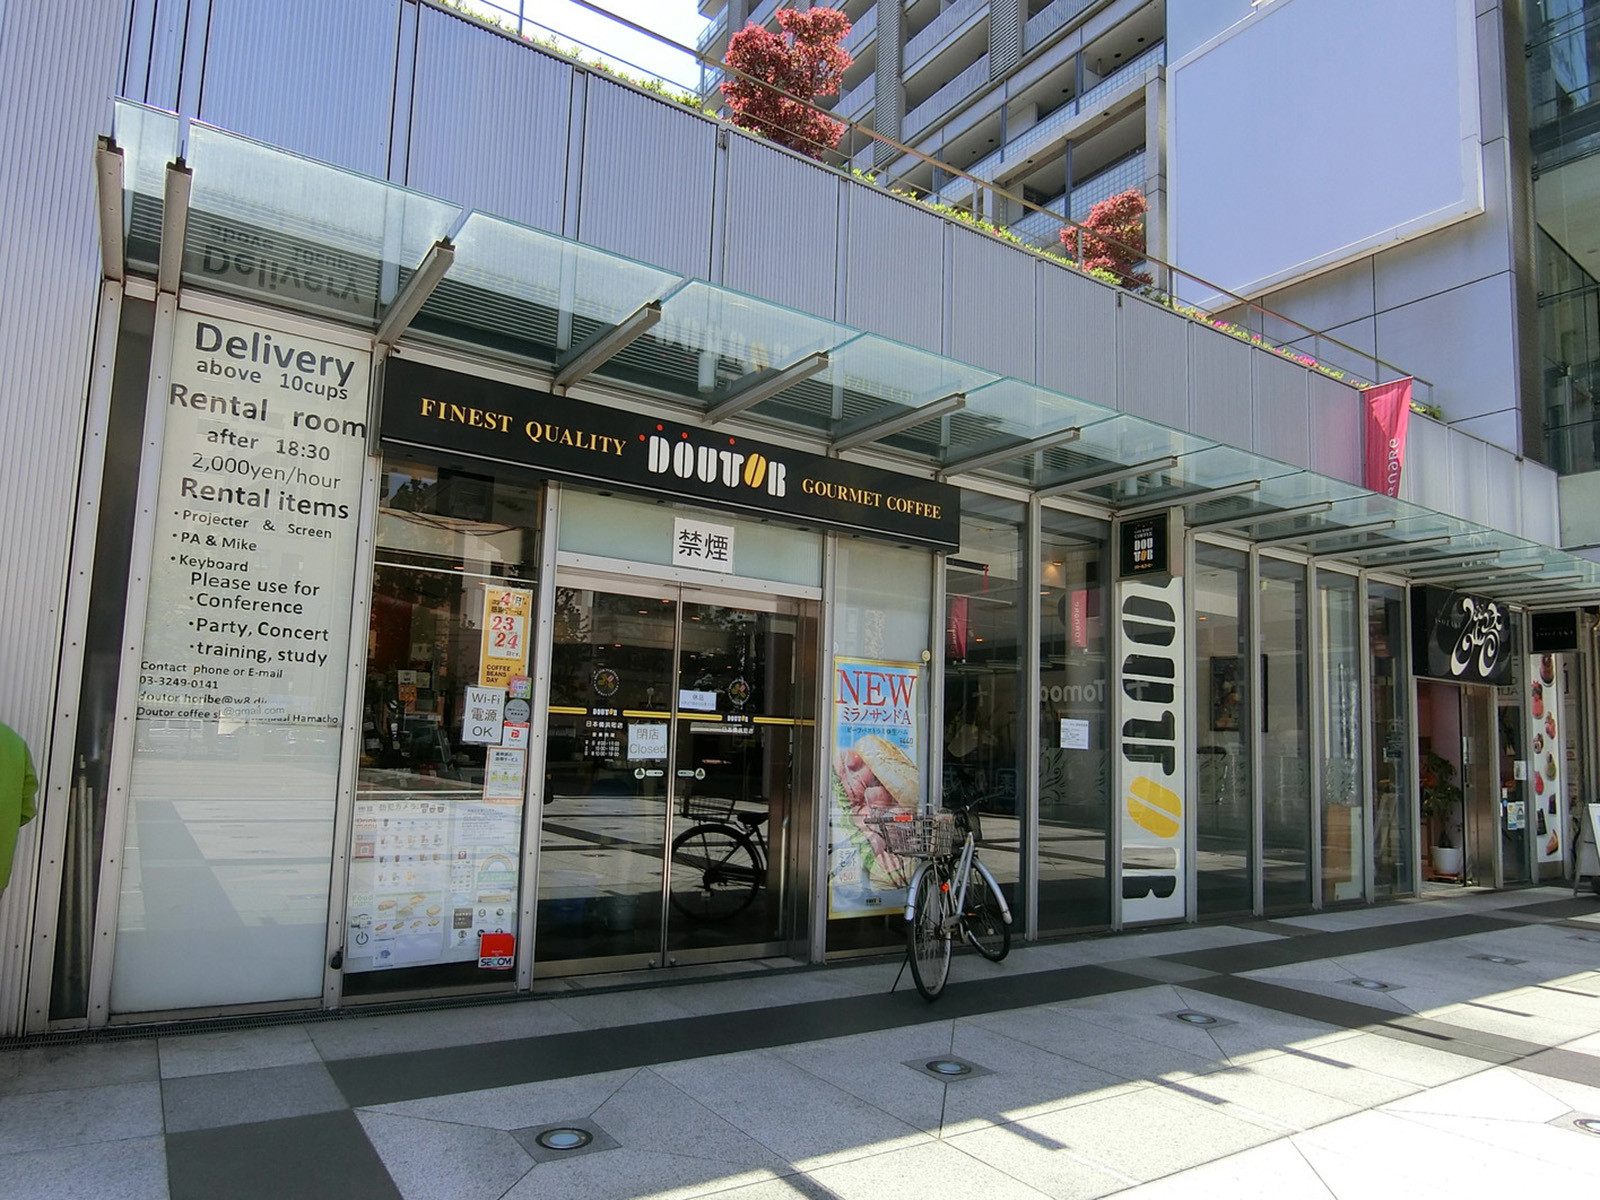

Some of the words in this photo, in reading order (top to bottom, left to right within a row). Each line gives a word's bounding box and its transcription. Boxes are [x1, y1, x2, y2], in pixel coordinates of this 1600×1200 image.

[195, 322, 355, 387] Delivery
[196, 358, 262, 383] above
[280, 373, 348, 401] 10cups
[169, 383, 268, 421] Rental
[292, 410, 367, 438] room
[420, 397, 513, 433] FINEST
[525, 421, 627, 456] QUALITY
[207, 429, 258, 449] after
[276, 439, 330, 461] 18:30
[192, 453, 341, 489] 2,000yen/hour
[647, 435, 787, 498] DOUTOR
[181, 477, 270, 508] Rental
[278, 492, 349, 519] items
[802, 478, 882, 507] GOURMET
[886, 496, 942, 519] COFFEE
[183, 510, 249, 529] Projecter
[262, 520, 276, 532] &
[288, 523, 333, 539] Screen
[181, 532, 201, 545] PA
[205, 534, 217, 546] &
[222, 537, 257, 551] Mike
[678, 529, 729, 561] 禁煙
[179, 554, 249, 573] Keyboard
[191, 572, 251, 591] Please
[257, 581, 288, 594] use
[294, 580, 320, 597] for
[196, 593, 304, 615] Conference
[196, 618, 253, 638] Party,
[257, 621, 330, 642] Concert
[491, 616, 515, 631] 23
[494, 632, 519, 649] 24
[196, 641, 272, 663] training,
[278, 648, 328, 667] study
[140, 660, 187, 673] Contact
[193, 664, 230, 676] phone
[233, 667, 246, 676] or
[248, 667, 284, 679] E-mail
[487, 664, 511, 672] COFFEE
[487, 670, 508, 678] BEANS
[138, 674, 219, 690] 03-3249-0141
[835, 669, 920, 708] NEW
[472, 692, 501, 705] Wi-Fi
[136, 706, 175, 718] Doutor
[177, 707, 211, 718] coffee
[471, 707, 497, 722] 電源
[843, 706, 913, 726] ミラノサンドA
[472, 725, 494, 738] OK
[1122, 574, 1182, 899] OUTOR
[629, 742, 667, 755] Closed
[480, 957, 512, 967] SECOM
